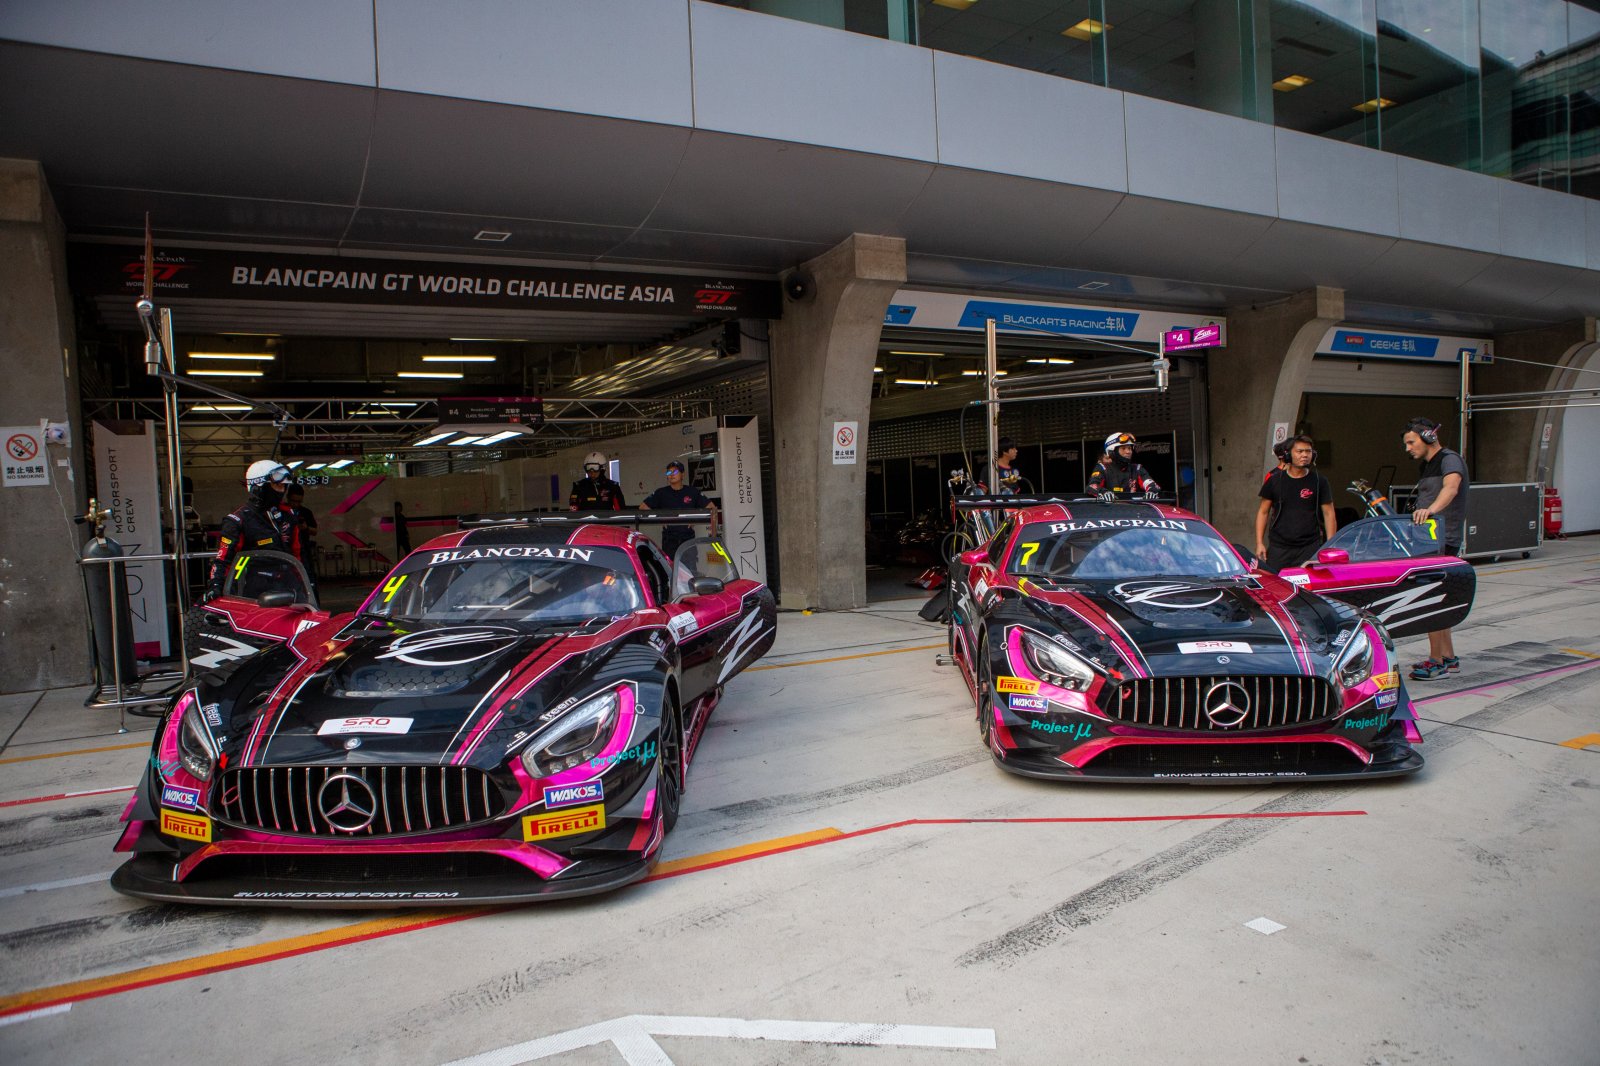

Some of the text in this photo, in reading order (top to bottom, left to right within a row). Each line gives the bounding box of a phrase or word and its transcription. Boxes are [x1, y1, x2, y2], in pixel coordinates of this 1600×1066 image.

[232, 266, 675, 303] BLANCPAIN GT WORLD CHALLENGE ASIA
[1003, 313, 1067, 327] BLACKARTS
[1068, 318, 1106, 330] RACING
[1370, 339, 1400, 350] GEEKE
[6, 465, 44, 474] 禁止吸烟
[735, 435, 745, 504] MOTORSPORT
[107, 447, 124, 534] MOTORSPORT
[127, 498, 136, 533] CREW
[1049, 519, 1188, 535] BLANCPAIN
[428, 547, 594, 566] BLANCPAIN
[738, 514, 759, 576] ZUN
[1020, 542, 1040, 566] 7
[234, 556, 250, 580] 4
[382, 574, 408, 603] 4
[999, 677, 1035, 691] PIRELLI
[342, 717, 391, 727] SRO
[1031, 719, 1075, 734] Project
[1345, 715, 1378, 730] Project
[590, 745, 641, 769] Project
[164, 814, 206, 837] PIRELLI
[530, 810, 599, 836] PIRELLI
